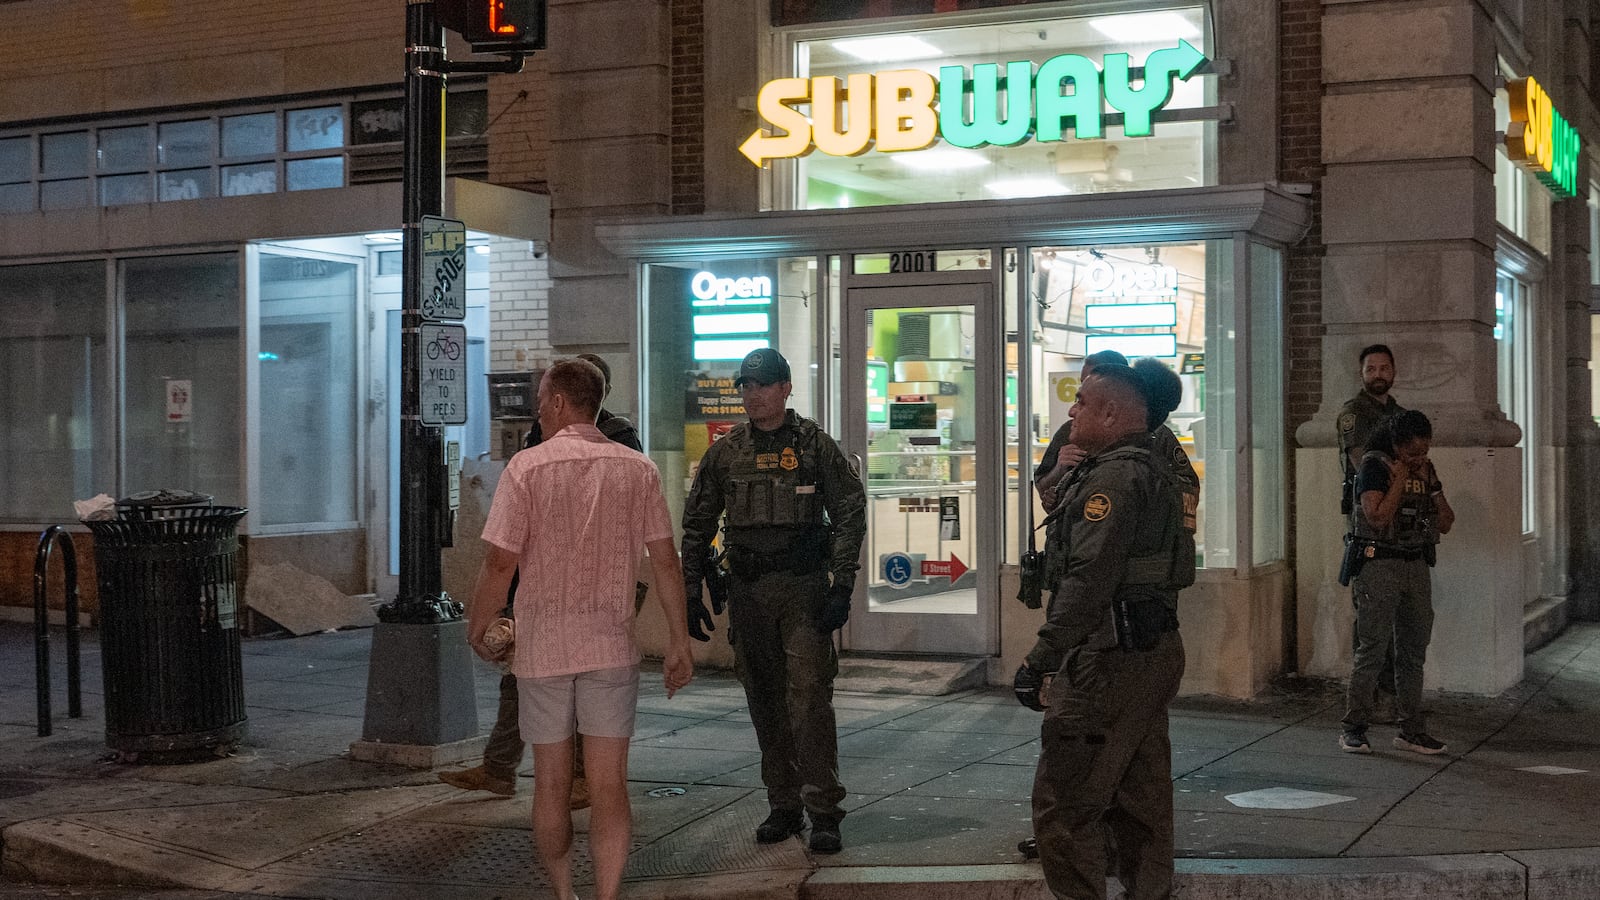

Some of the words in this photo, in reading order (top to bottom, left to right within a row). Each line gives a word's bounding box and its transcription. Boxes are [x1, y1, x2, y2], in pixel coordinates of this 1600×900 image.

[738, 38, 1205, 168] SUBWAY
[890, 252, 936, 273] 2001
[1086, 259, 1178, 297] Open
[692, 271, 772, 306] Open
[429, 368, 455, 380] YIELD
[697, 379, 716, 388] BUY
[438, 386, 448, 398] TO
[433, 403, 456, 416] PEDS
[701, 406, 719, 414] FOR
[1405, 480, 1425, 494] FBI
[930, 563, 951, 573] Street
